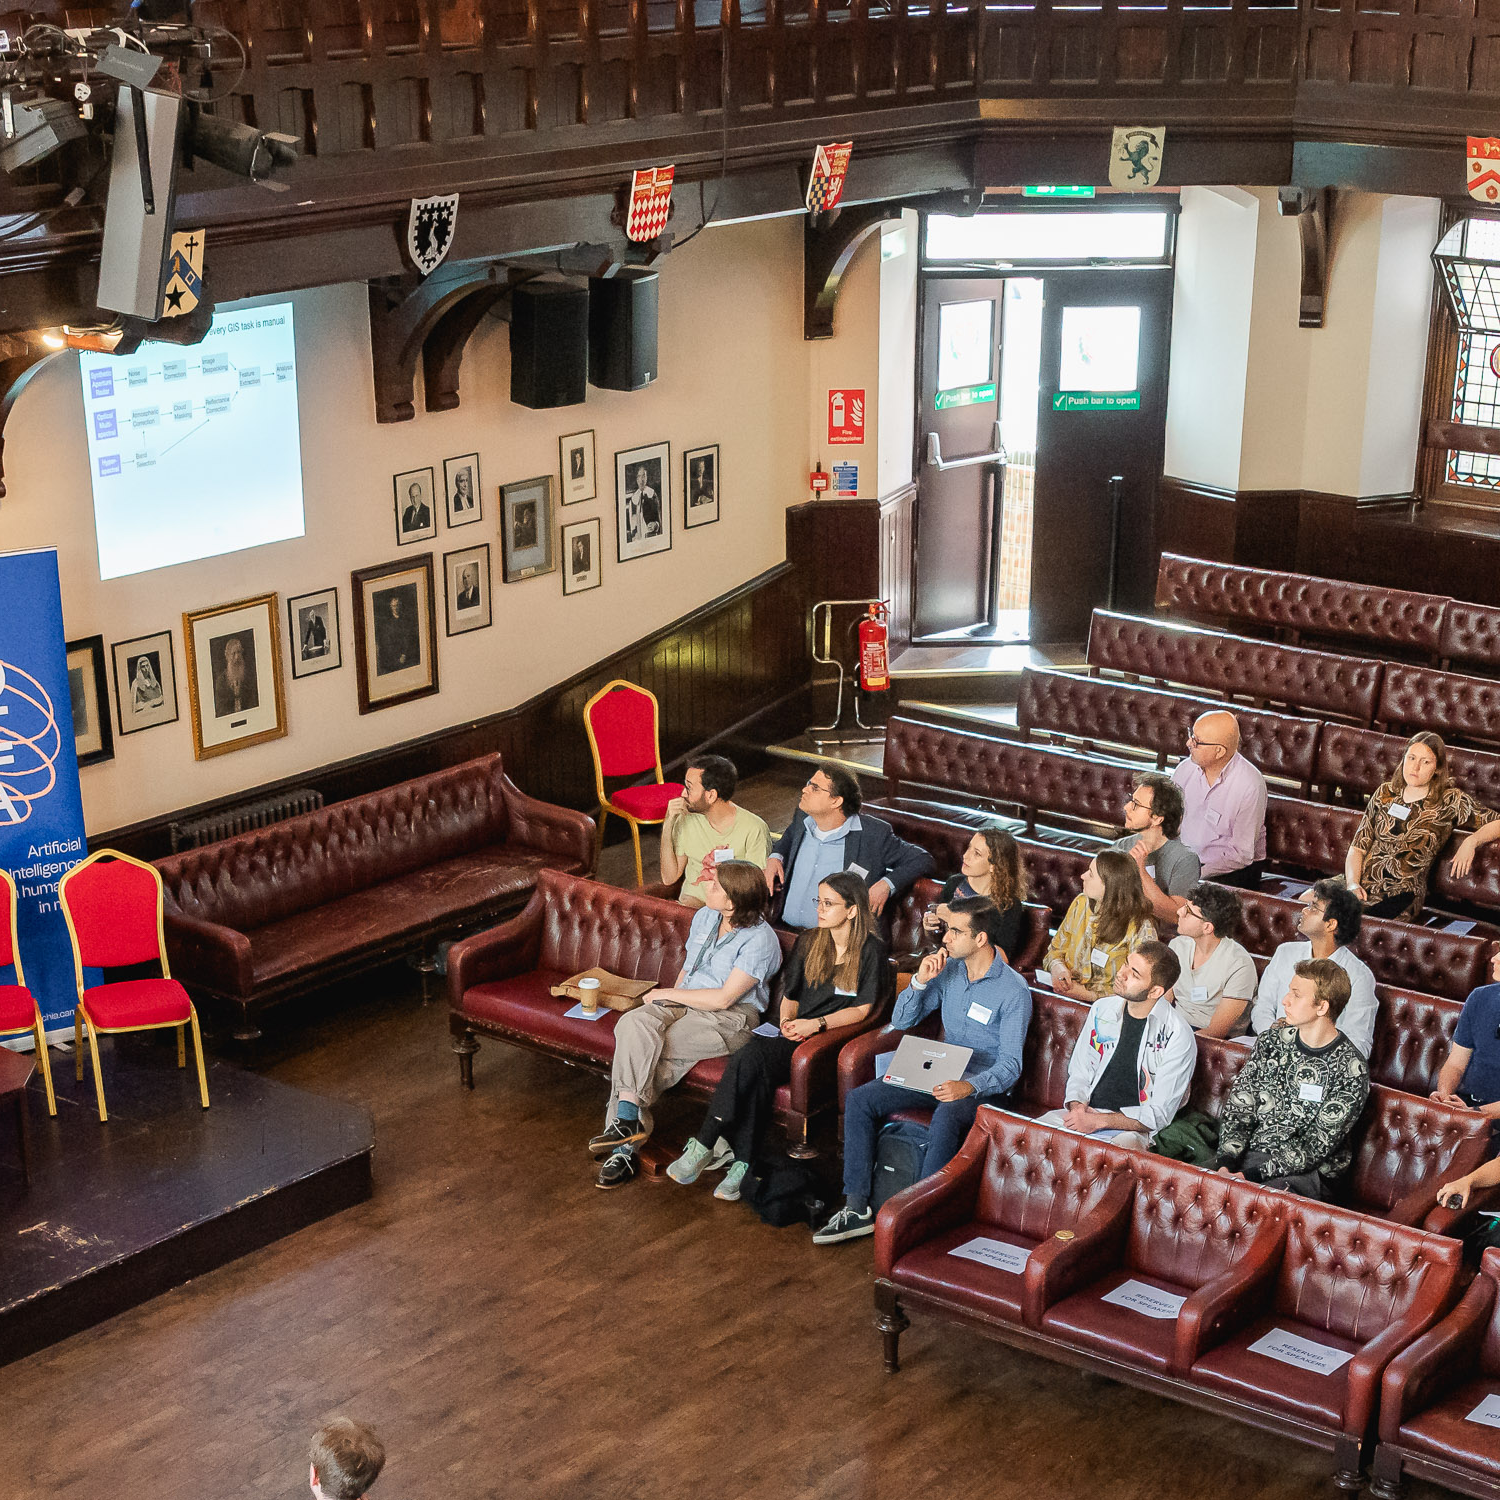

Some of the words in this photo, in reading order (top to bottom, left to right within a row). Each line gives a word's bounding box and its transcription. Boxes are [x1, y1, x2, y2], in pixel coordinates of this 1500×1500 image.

[227, 322, 240, 333] GIS
[241, 320, 255, 331] task
[255, 320, 261, 328] is
[263, 316, 285, 327] manual
[979, 389, 993, 400] open
[1068, 396, 1089, 406] Push
[1090, 396, 1104, 405] bar
[1106, 397, 1115, 405] to
[1116, 398, 1137, 407] open
[27, 836, 82, 859] Artificial
[21, 881, 60, 898] huma
[38, 901, 51, 914] in
[980, 1253, 1021, 1268] SPEAKERS
[981, 1247, 1020, 1261] RESERVED
[1120, 1295, 1137, 1305] FOR
[1137, 1300, 1177, 1315] SPEAKERS
[1135, 1293, 1175, 1309] RESERVED
[1266, 1344, 1283, 1354] FOR
[1284, 1350, 1327, 1368] SPEAKERS
[1282, 1343, 1324, 1361] RESERVED
